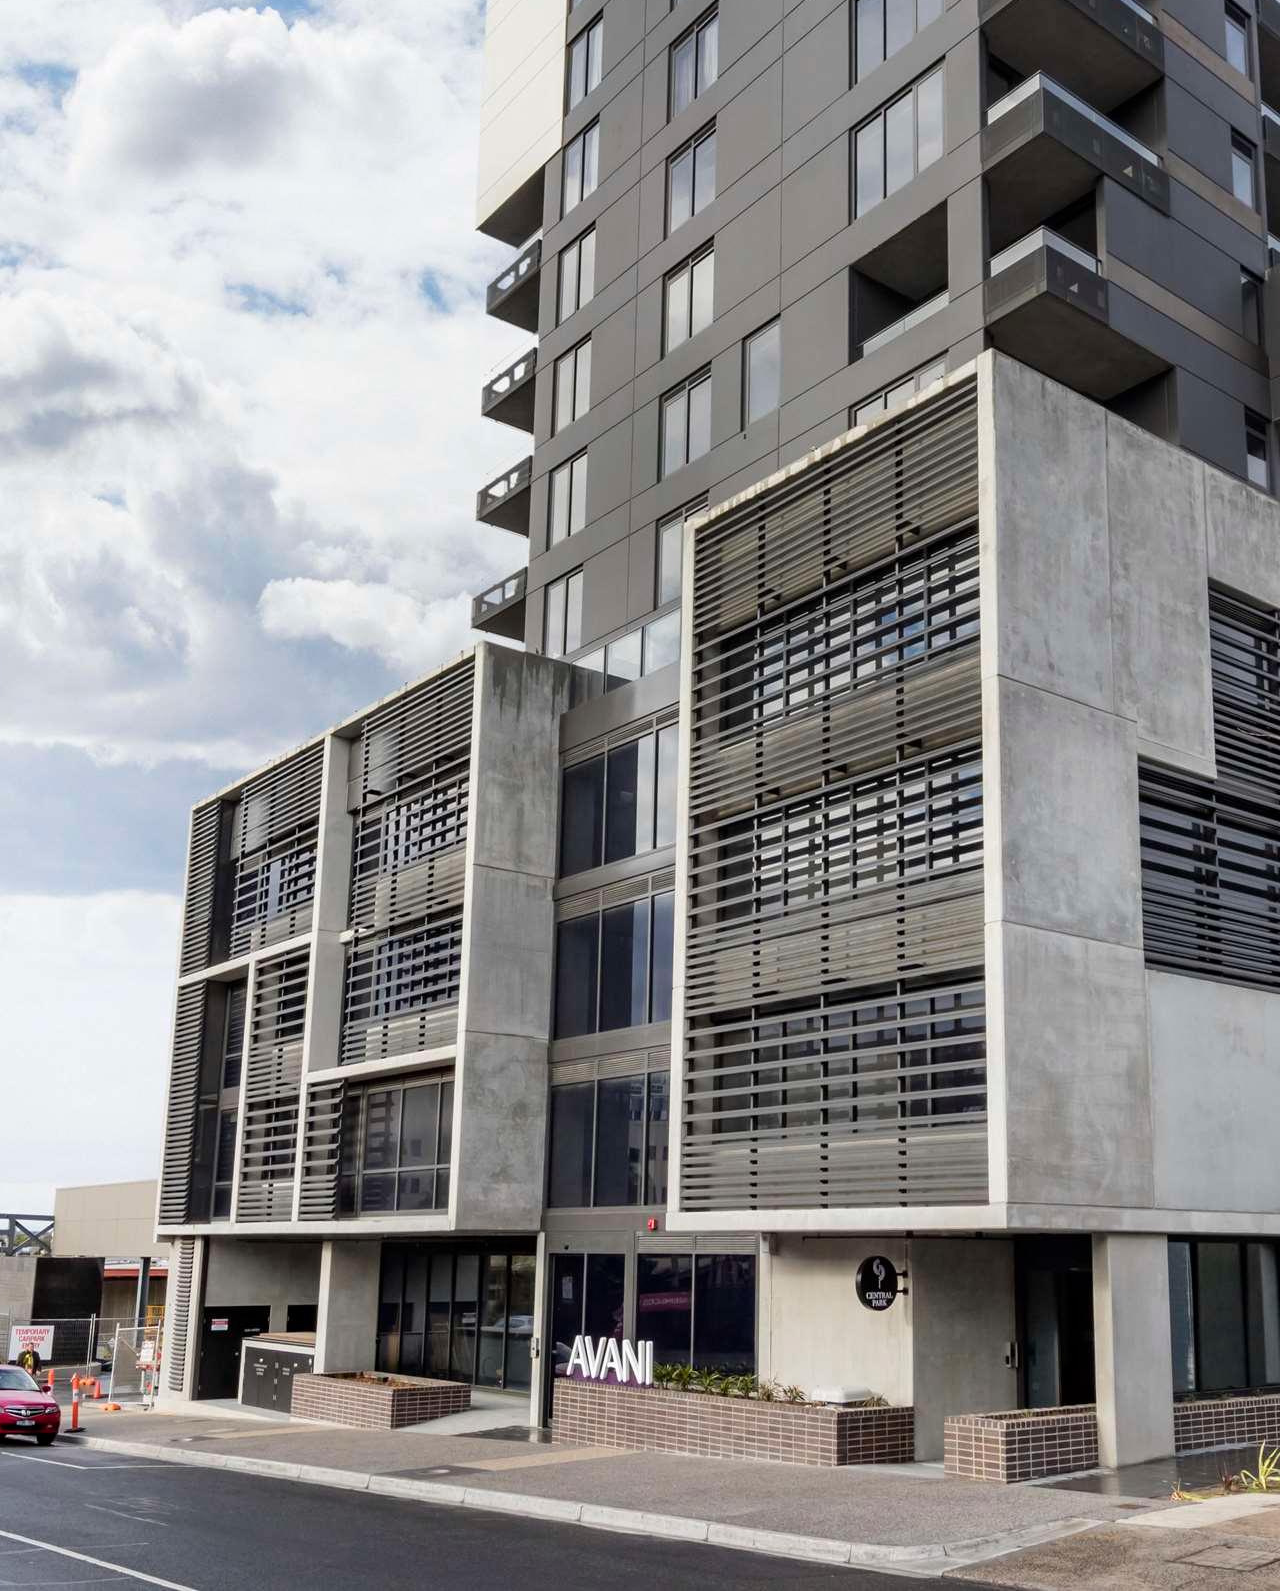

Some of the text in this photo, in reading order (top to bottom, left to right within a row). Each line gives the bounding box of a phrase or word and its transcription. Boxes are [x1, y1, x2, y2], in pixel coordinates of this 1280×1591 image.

[865, 1291, 894, 1300] CENTRAL
[871, 1299, 888, 1307] PARK
[566, 1335, 654, 1386] AVANI
